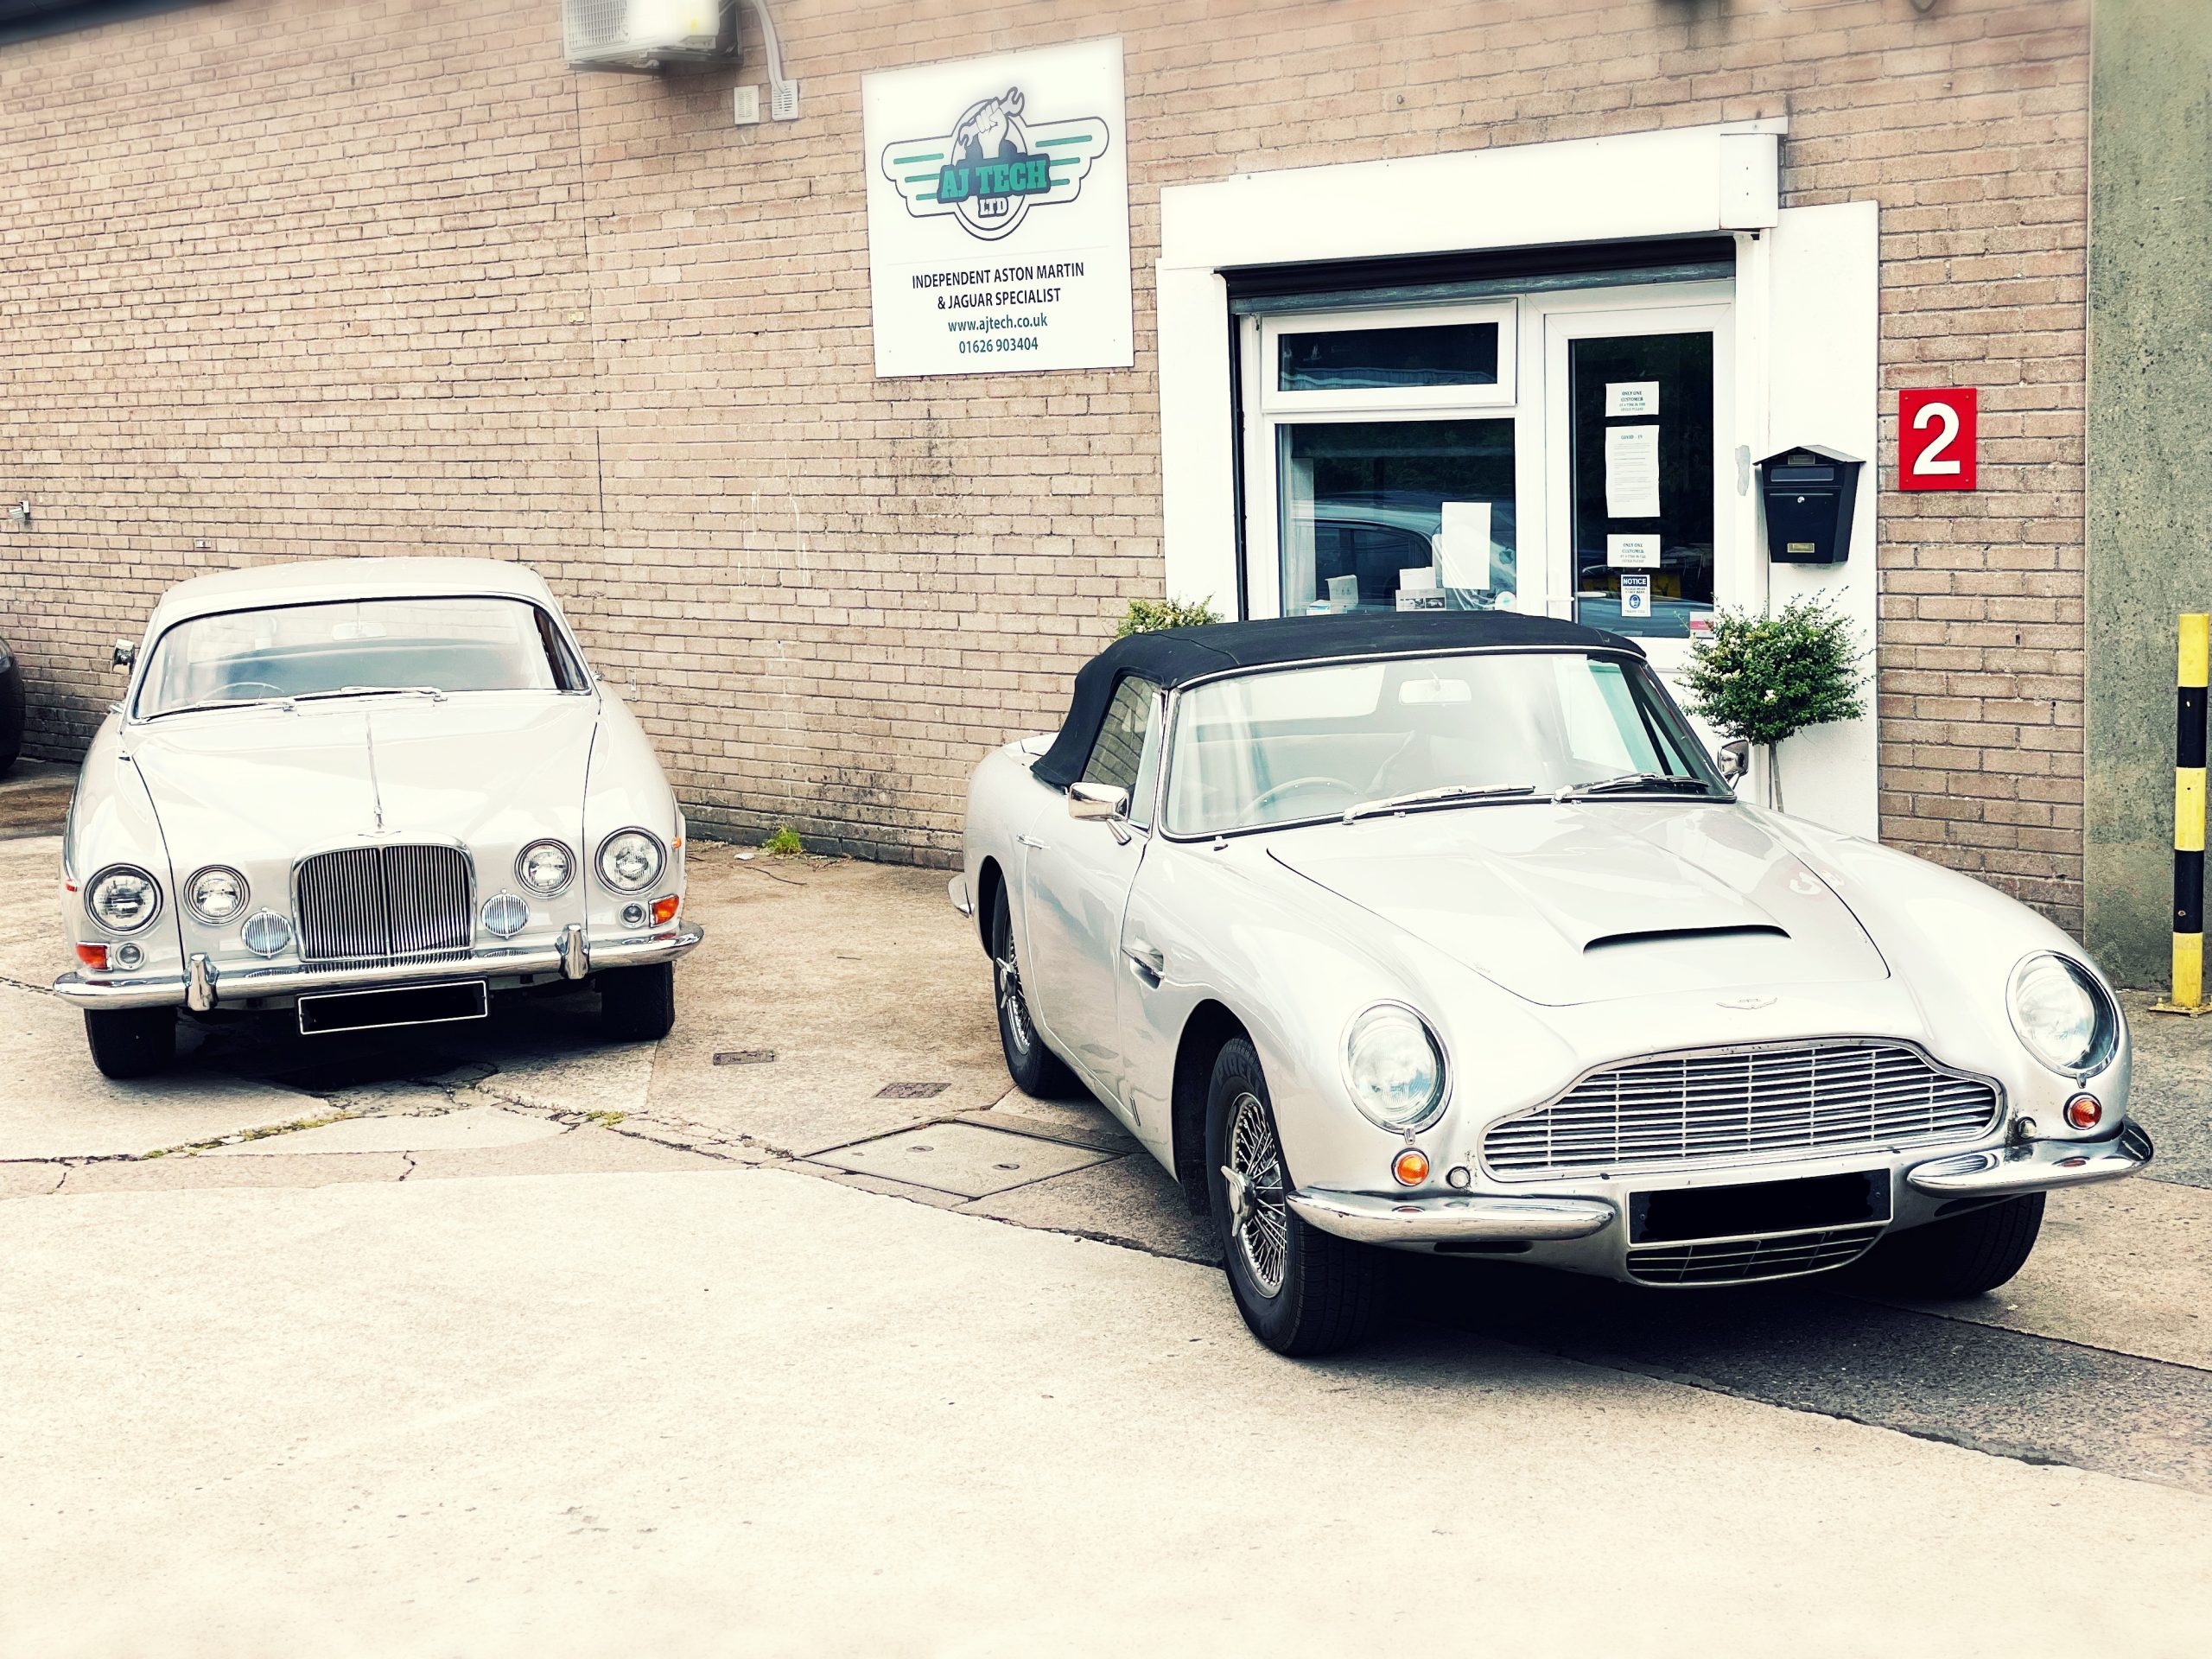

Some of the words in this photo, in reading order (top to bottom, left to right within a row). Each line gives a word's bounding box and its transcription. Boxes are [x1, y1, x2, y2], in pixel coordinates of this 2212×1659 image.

[941, 168, 969, 199] AJ
[976, 160, 1047, 194] TECH
[979, 197, 1008, 216] LTD
[912, 269, 991, 289] INDEPENDENT
[994, 265, 1033, 283] ASTON
[1037, 262, 1084, 279] MARTIN
[938, 296, 946, 309] &
[948, 292, 993, 308] JAGUAR
[995, 287, 1061, 306] SPECIALIST
[948, 312, 1048, 334] www.ajtech.co.uk
[958, 339, 994, 354] 01626
[995, 336, 1039, 353] 903404
[1912, 402, 1961, 475] 2
